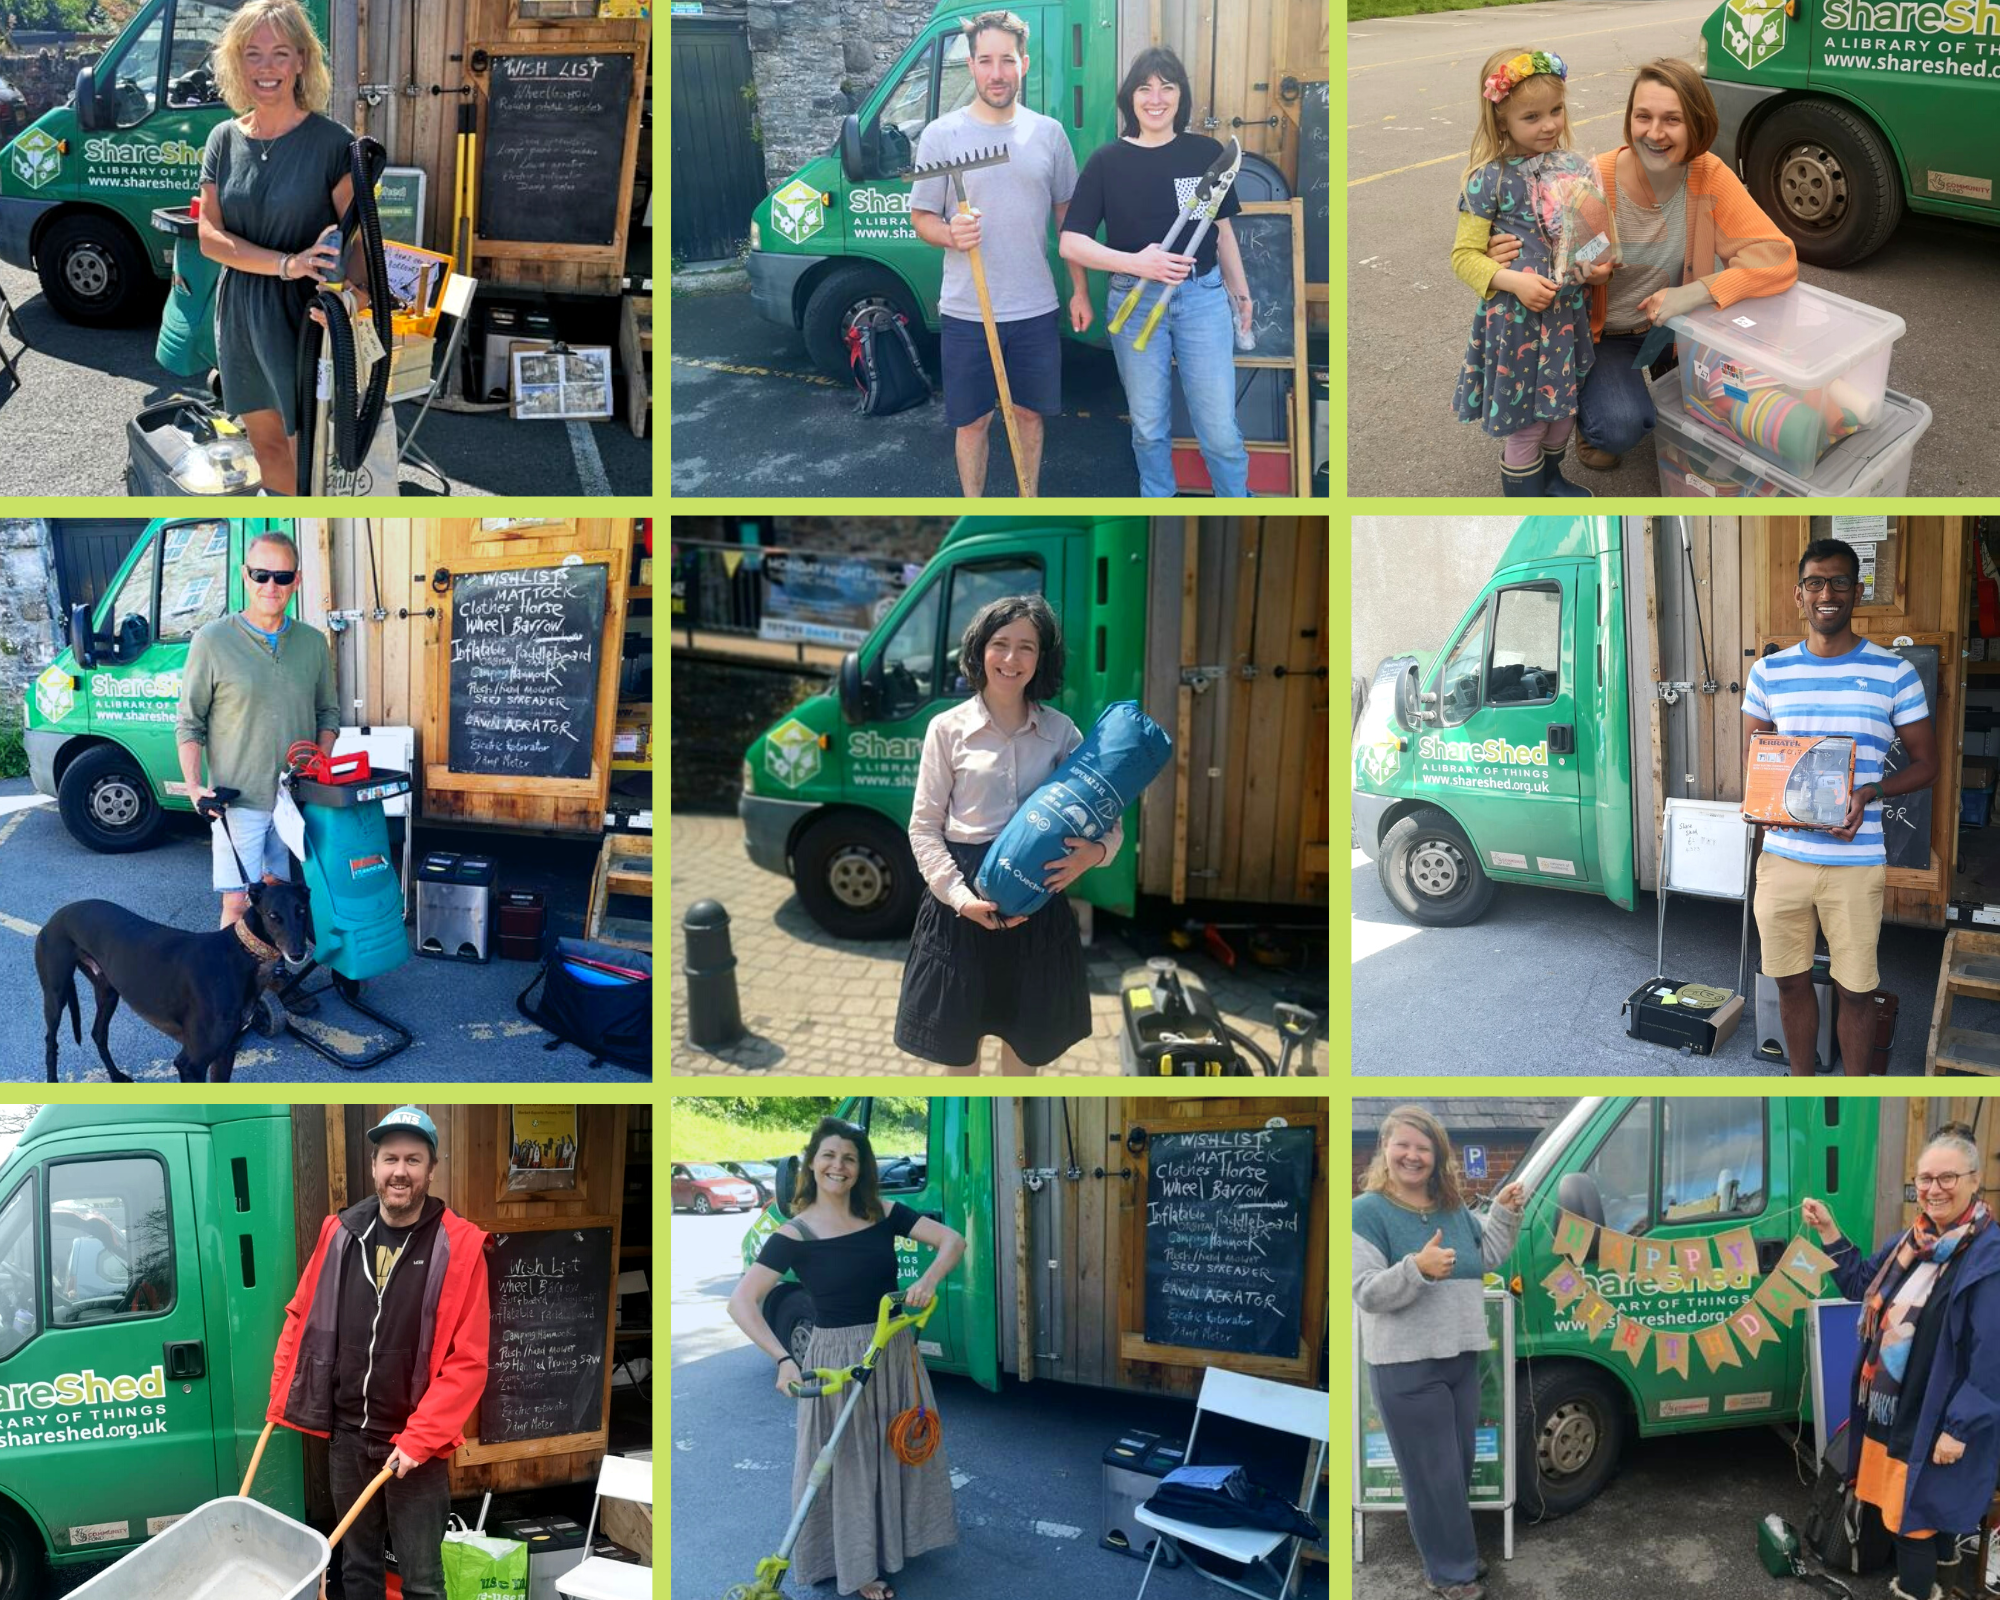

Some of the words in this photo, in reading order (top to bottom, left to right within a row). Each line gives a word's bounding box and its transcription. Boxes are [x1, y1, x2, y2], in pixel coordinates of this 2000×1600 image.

[1824, 37, 1836, 48] A
[1842, 37, 1931, 52] LIBRARY
[1938, 41, 1967, 54] OF
[88, 166, 96, 174] A
[99, 166, 157, 176] LIBRARY
[160, 168, 177, 176] OF
[182, 168, 201, 177] TH
[1946, 182, 1990, 193] COMMUNITY
[853, 217, 862, 226] A
[866, 217, 912, 226] LIBRA
[854, 227, 919, 239] www.sha
[459, 599, 514, 617] Clothes
[465, 614, 506, 635] Wheel
[510, 616, 566, 637] Barrow
[104, 700, 152, 709] LIBRARY
[156, 701, 169, 709] OF
[848, 730, 924, 760] Shar
[1418, 735, 1549, 766] ShareShed
[1422, 763, 1429, 771] A
[1431, 764, 1481, 774] LIBRARY
[1484, 767, 1499, 776] OF
[1503, 768, 1550, 779] THINGS
[1422, 774, 1551, 794] www.shareshed.org.uk
[386, 1111, 421, 1126] VANS
[1470, 1147, 1481, 1164] P
[1156, 1161, 1214, 1178] Clothes
[1220, 1161, 1268, 1182] Horse
[1162, 1177, 1204, 1200] Wheel
[1209, 1180, 1269, 1201] Barrow
[510, 1257, 545, 1275] Wish
[1658, 1298, 1680, 1310] OF
[1686, 1294, 1751, 1308] THINGS
[56, 1411, 82, 1424] OF
[90, 1404, 167, 1420] THINGS
